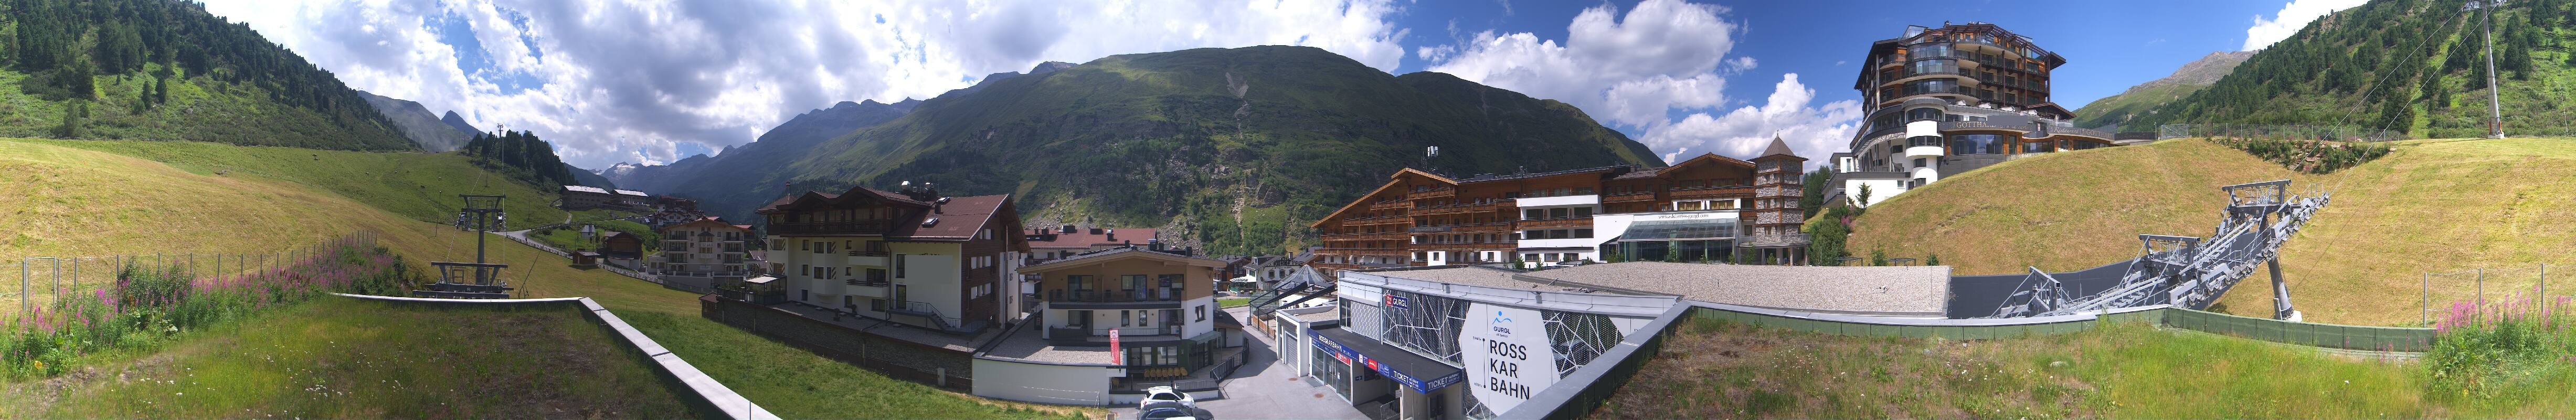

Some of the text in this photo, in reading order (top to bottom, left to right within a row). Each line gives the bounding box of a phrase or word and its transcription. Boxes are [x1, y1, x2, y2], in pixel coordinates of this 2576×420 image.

[1393, 298, 1407, 307] GURGL
[1319, 334, 1342, 351] ROSSKARBAHN
[1490, 339, 1526, 361] ROSS
[1393, 370, 1409, 383] TICKET
[1490, 358, 1518, 379] KAR
[1427, 376, 1448, 389] TICKET
[1491, 376, 1530, 400] BAHN
